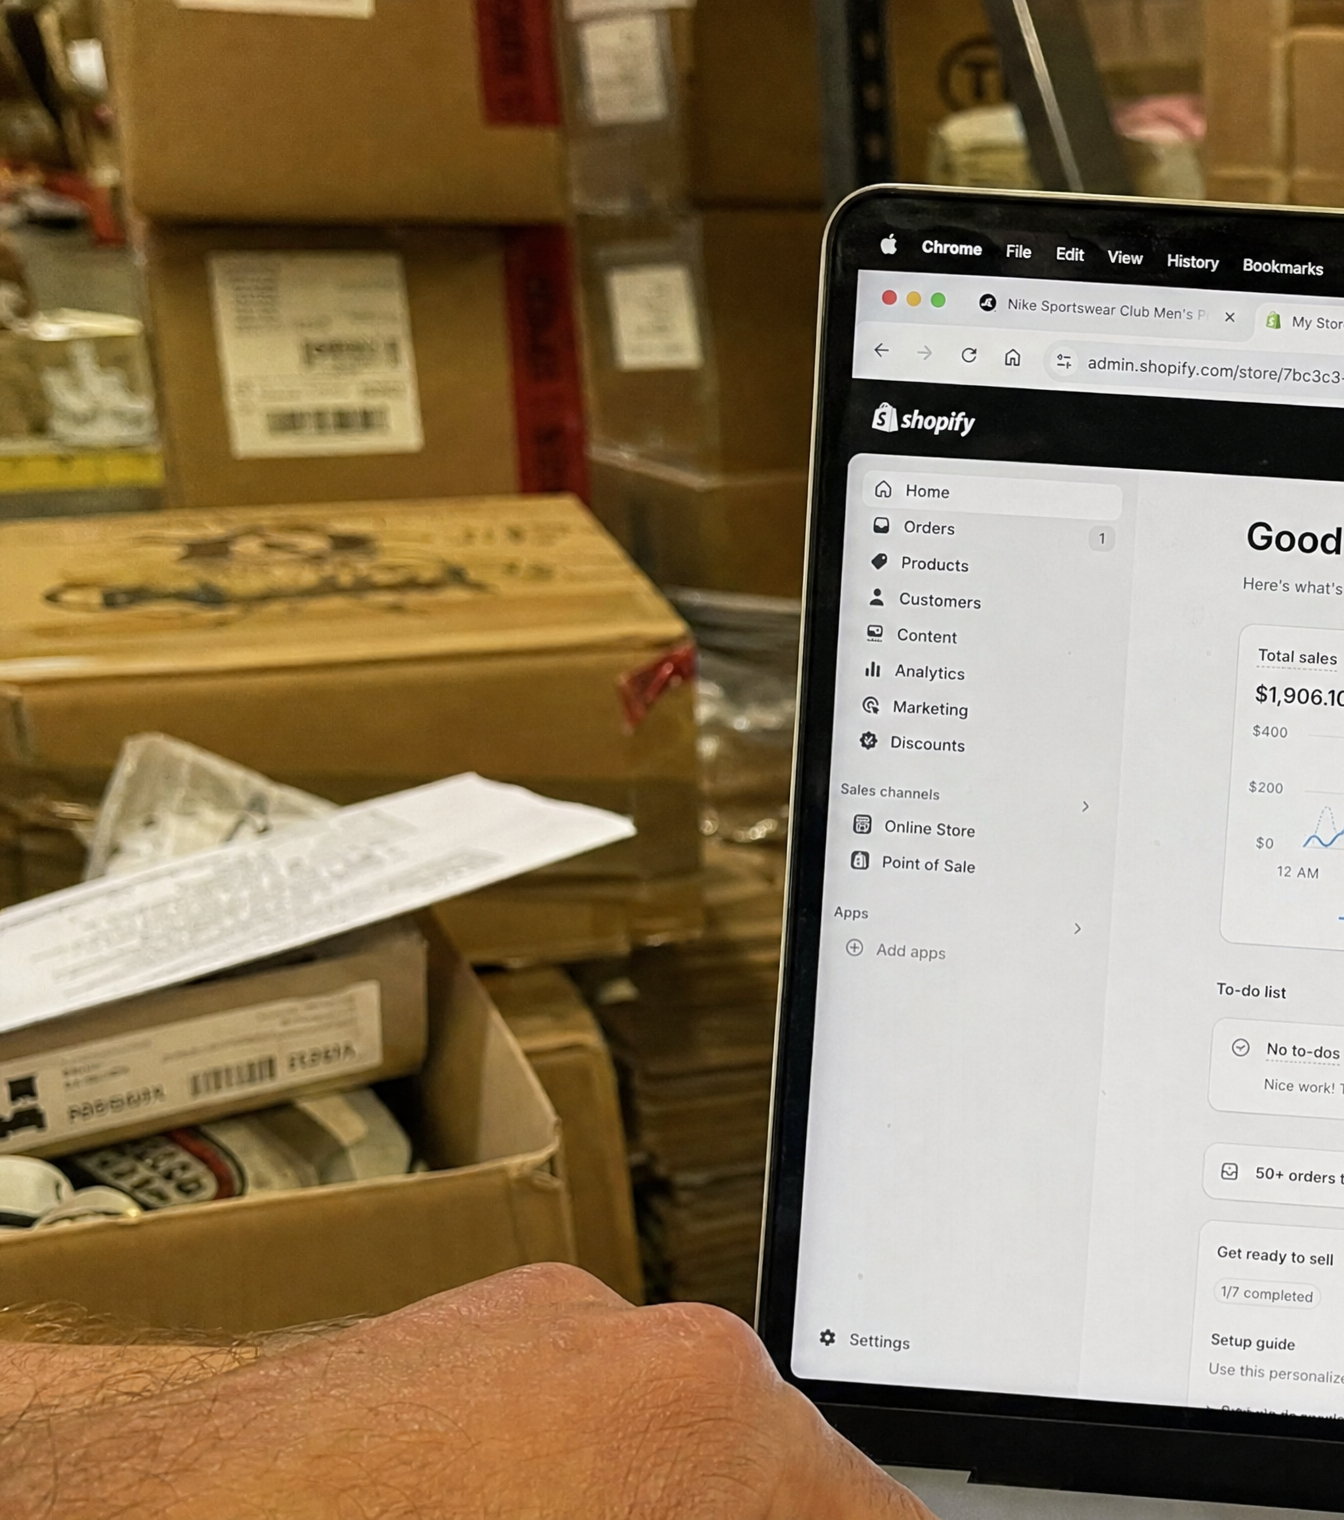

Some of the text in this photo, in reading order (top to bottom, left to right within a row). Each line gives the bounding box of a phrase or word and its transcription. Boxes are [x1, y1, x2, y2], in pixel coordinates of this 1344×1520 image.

[921, 239, 983, 256] Chrome
[1005, 243, 1032, 259] File
[1055, 245, 1085, 262] Edit
[1106, 249, 1144, 265] View
[1167, 252, 1220, 273] History
[1242, 257, 1324, 276] Bookmarks
[1007, 297, 1193, 320] Nike Sportswear Club Men's
[1291, 315, 1313, 331] My
[900, 408, 976, 438] shopify
[905, 483, 950, 499] Home
[903, 519, 955, 536] Orders
[1098, 532, 1105, 545] 1
[1246, 520, 1343, 555] Good
[901, 555, 969, 573] Products
[1242, 576, 1290, 593] Here's
[1294, 580, 1343, 596] what's
[899, 591, 982, 610] Customers
[896, 627, 958, 645] Content
[1257, 647, 1338, 666] Total sales
[894, 663, 965, 682] Analytics
[892, 699, 968, 720] Marketing
[1252, 723, 1288, 739] $400
[890, 734, 966, 753] Discounts
[840, 782, 940, 801] Sales channels
[1248, 779, 1284, 795] $200
[884, 818, 976, 838] Online Store
[1255, 835, 1274, 850] $0
[881, 855, 976, 874] Point of Sale
[833, 905, 869, 922] Apps
[875, 942, 946, 962] Add apps
[1216, 981, 1286, 1000] To-do list
[1266, 1041, 1340, 1060] No to-dos
[1263, 1077, 1294, 1092] Nice
[1297, 1081, 1335, 1095] work!
[1255, 1166, 1284, 1180] 50+
[1288, 1170, 1336, 1185] orders
[1216, 1245, 1334, 1266] Get ready to sell
[1220, 1285, 1314, 1303] 1/7 completed
[849, 1332, 910, 1352] Settings
[1210, 1332, 1296, 1352] Setup guide
[1208, 1361, 1236, 1376] Use
[1239, 1364, 1265, 1378] this
